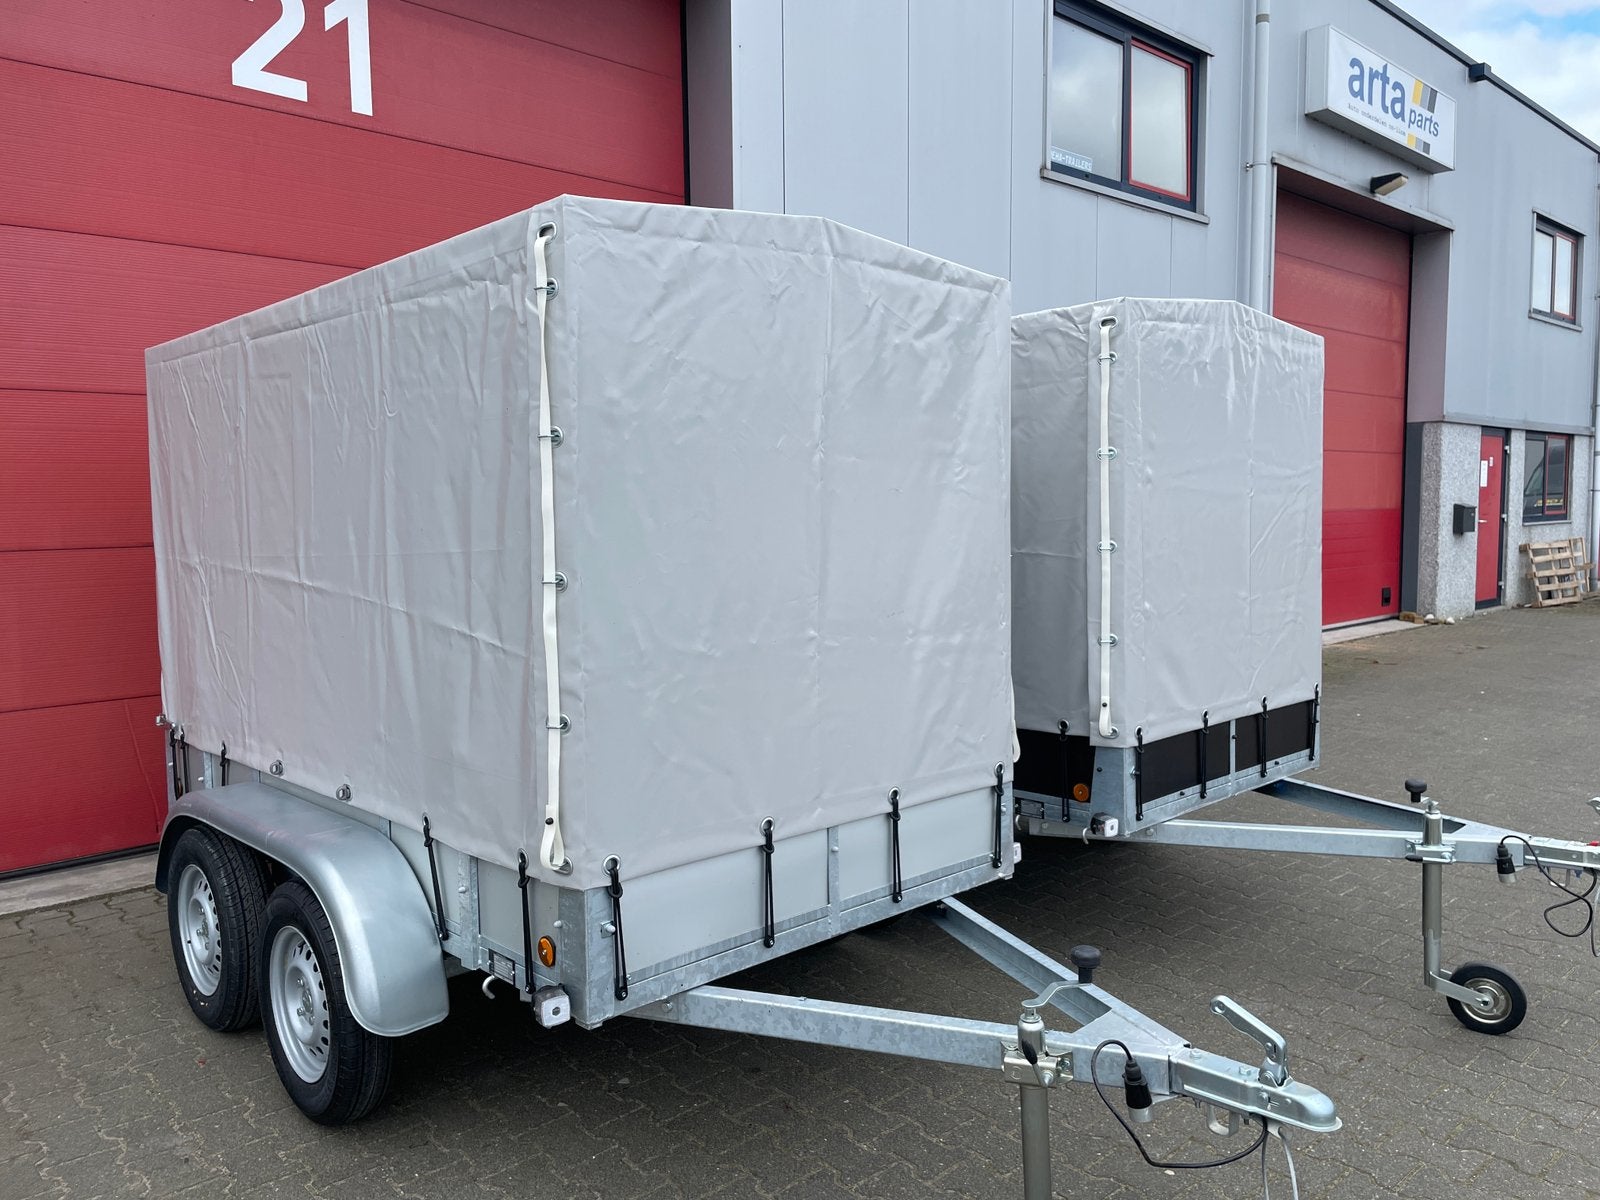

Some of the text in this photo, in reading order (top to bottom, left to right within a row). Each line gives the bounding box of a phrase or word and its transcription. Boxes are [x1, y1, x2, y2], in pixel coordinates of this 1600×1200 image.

[232, 0, 373, 116] 21
[1348, 57, 1439, 137] arta parts
[1051, 151, 1092, 170] EHA-TRAILERS
